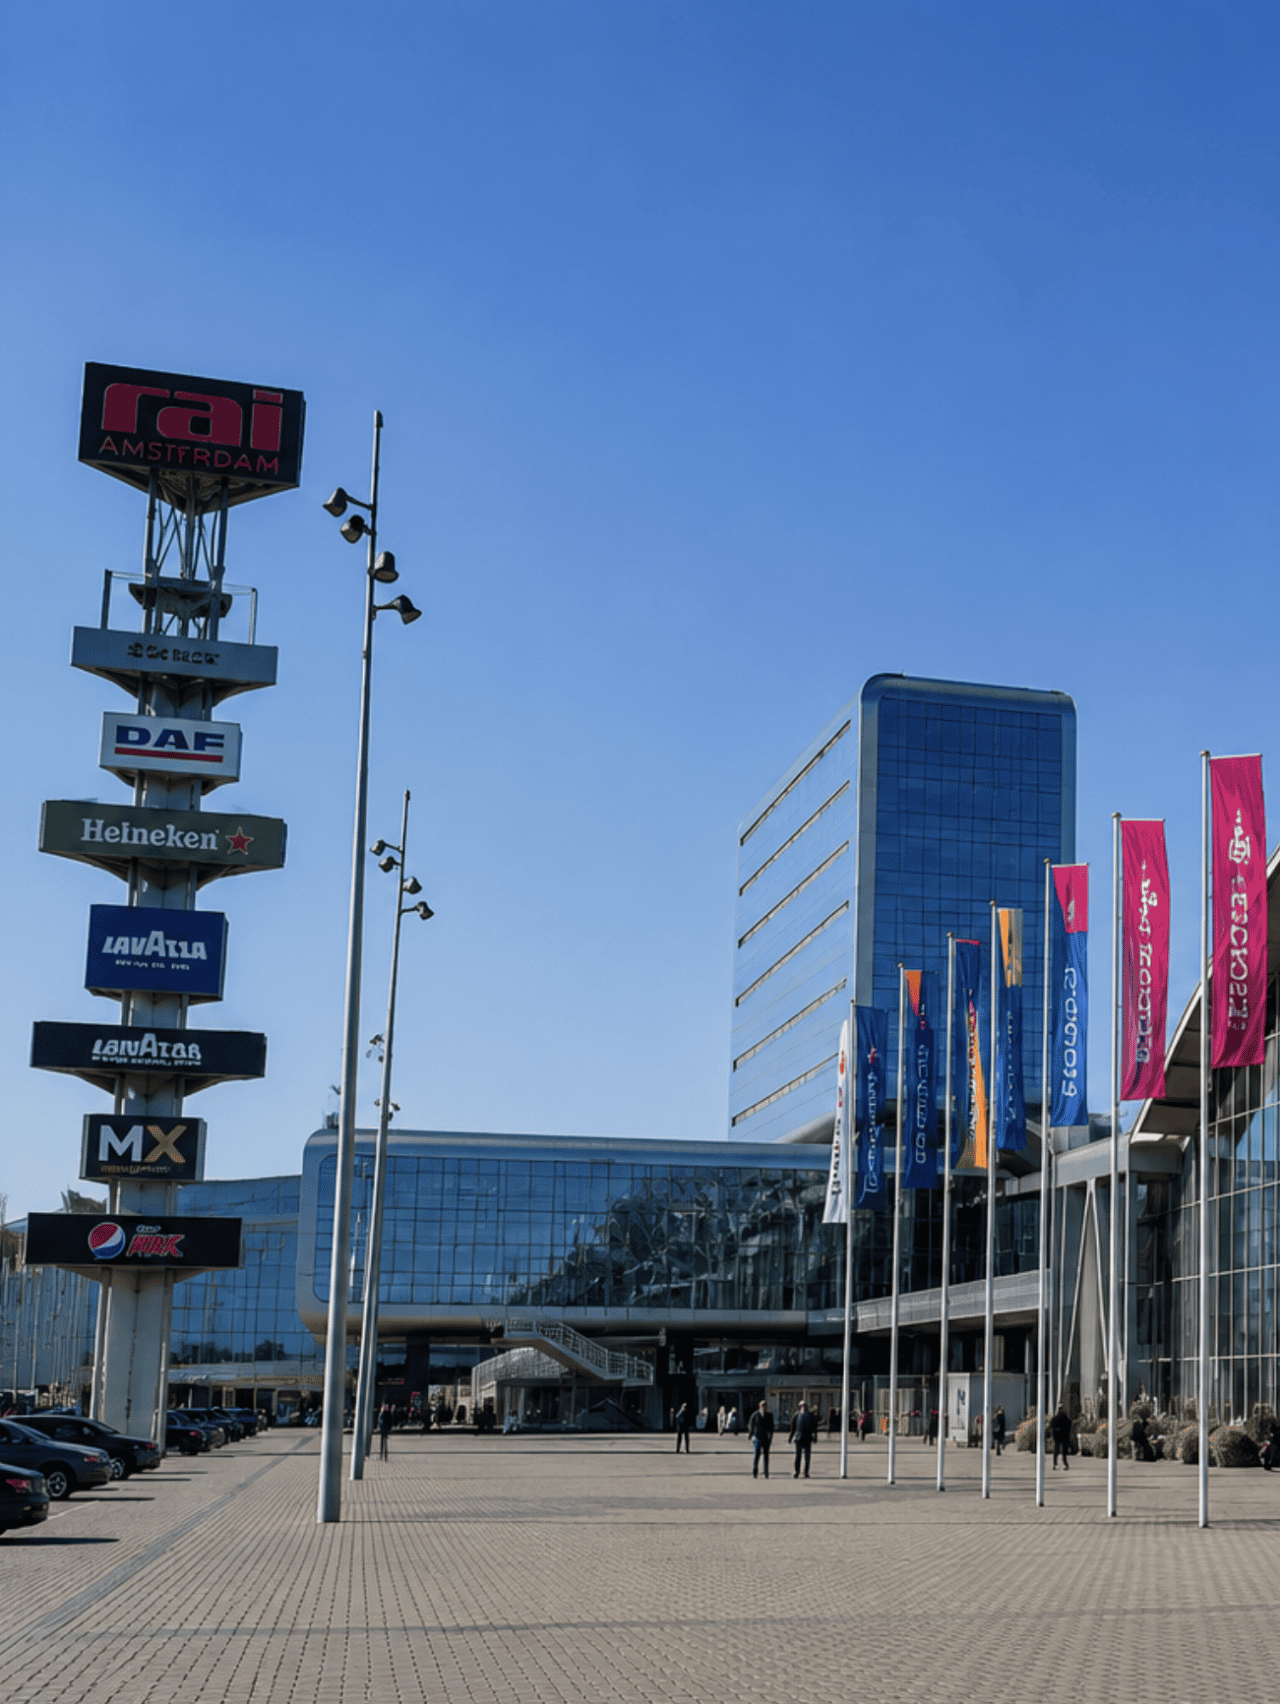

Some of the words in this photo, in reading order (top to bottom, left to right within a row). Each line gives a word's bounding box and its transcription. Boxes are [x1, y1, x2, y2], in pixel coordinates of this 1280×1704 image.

[101, 382, 284, 452] rai
[115, 724, 225, 752] DAF
[80, 818, 218, 851] Heineken
[98, 1124, 188, 1163] MX
